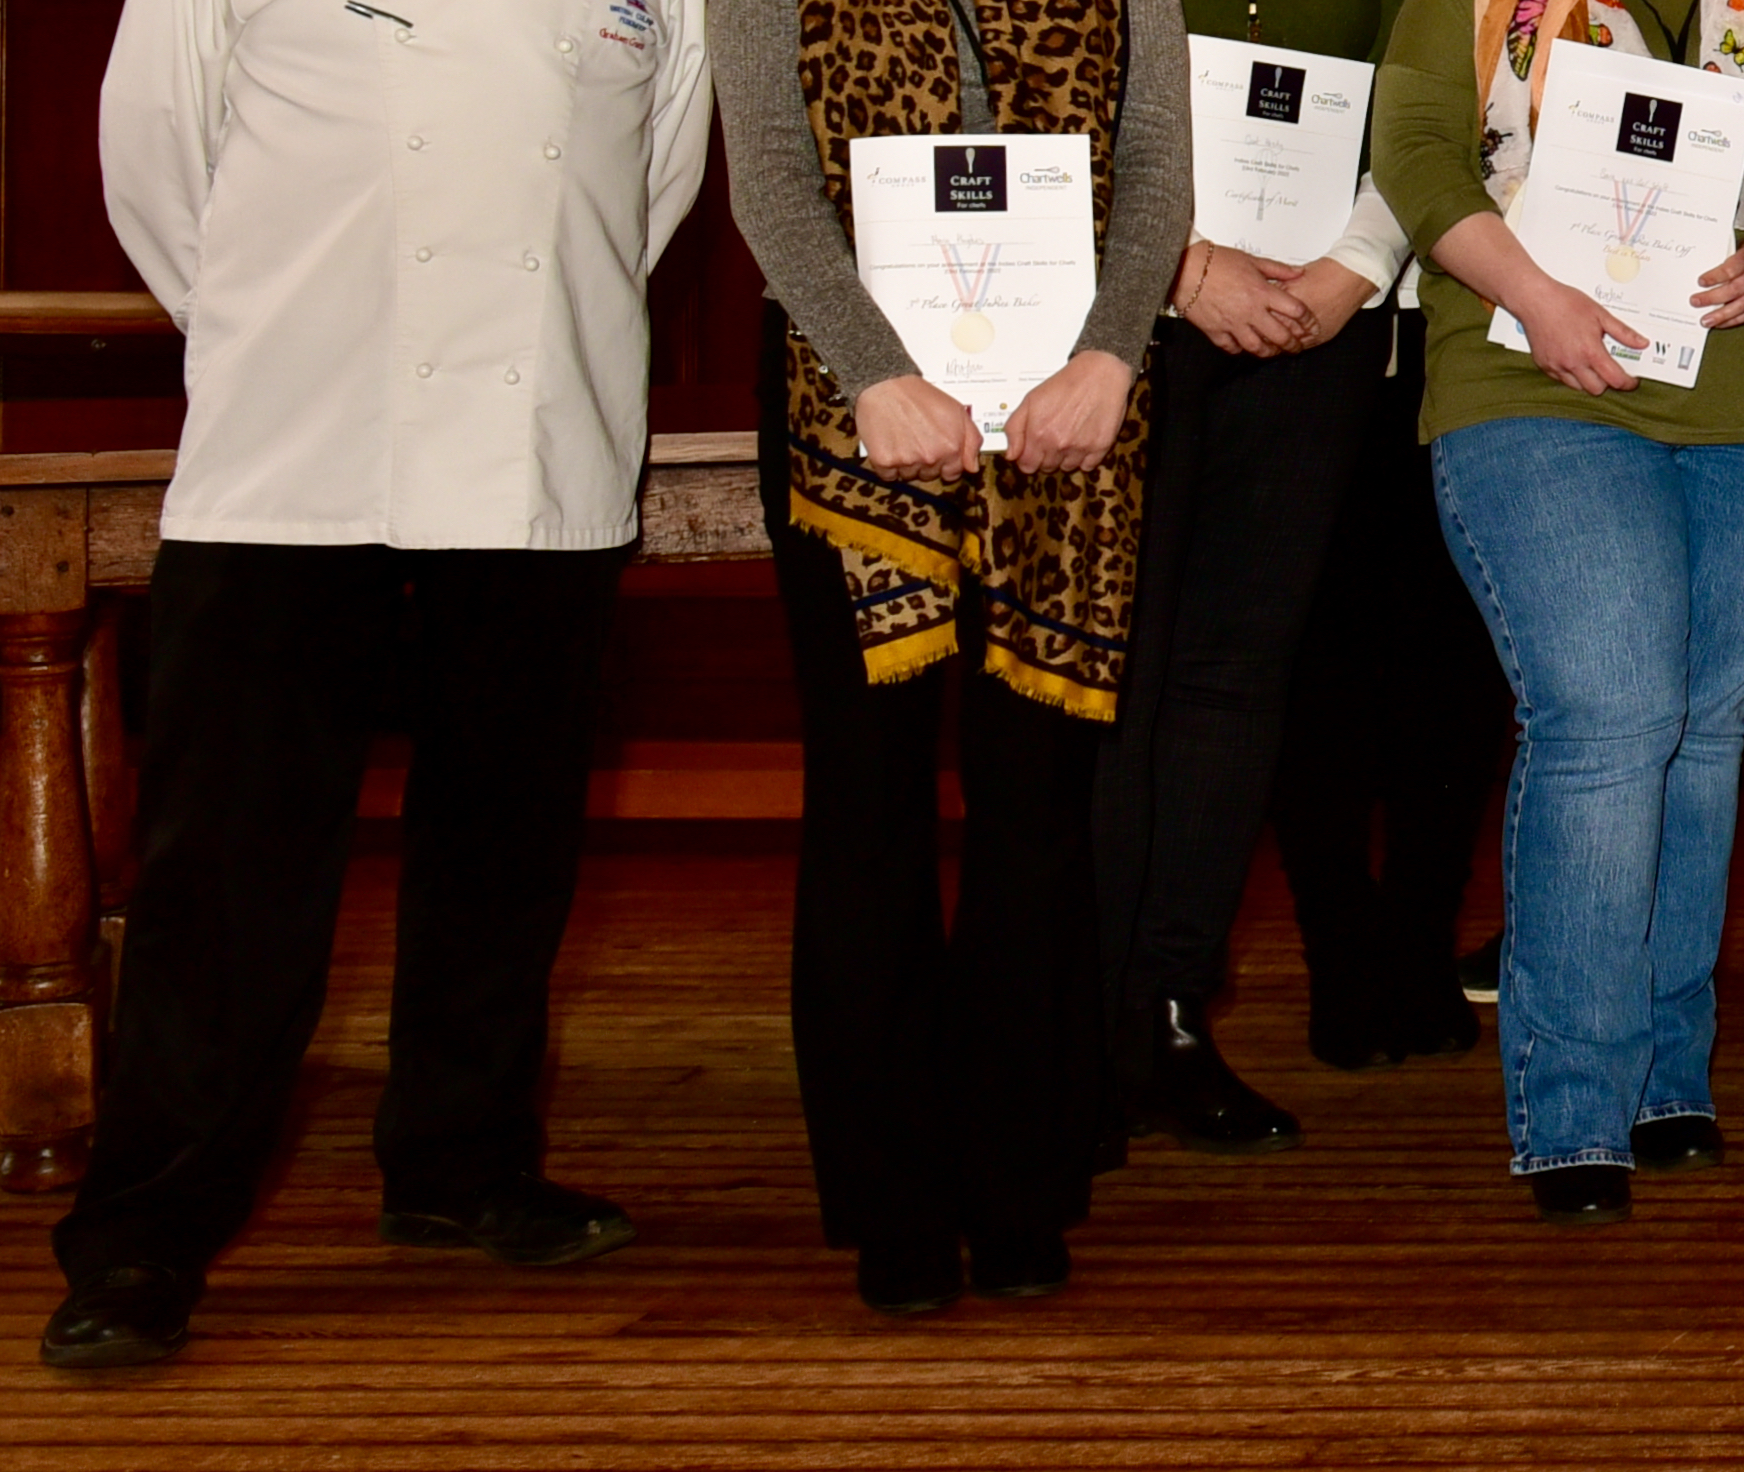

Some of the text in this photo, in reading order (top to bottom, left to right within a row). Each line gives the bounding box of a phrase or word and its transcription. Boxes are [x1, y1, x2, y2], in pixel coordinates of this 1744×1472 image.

[1206, 79, 1244, 90] COMPASS
[1260, 88, 1291, 100] CRAFT
[1259, 100, 1289, 112] SKILLS
[1311, 94, 1351, 109] Chartwells
[1577, 110, 1615, 124] COMPASS
[1633, 122, 1666, 136] CRAFT
[1630, 135, 1664, 149] SKILLS
[1688, 131, 1731, 148] Chartwells
[878, 176, 927, 185] COMPASS
[950, 176, 992, 186] CRAFT
[1020, 171, 1073, 184] Chartwells
[950, 190, 993, 201] SKILLS
[869, 263, 916, 271] Congratulations
[921, 296, 947, 309] Place
